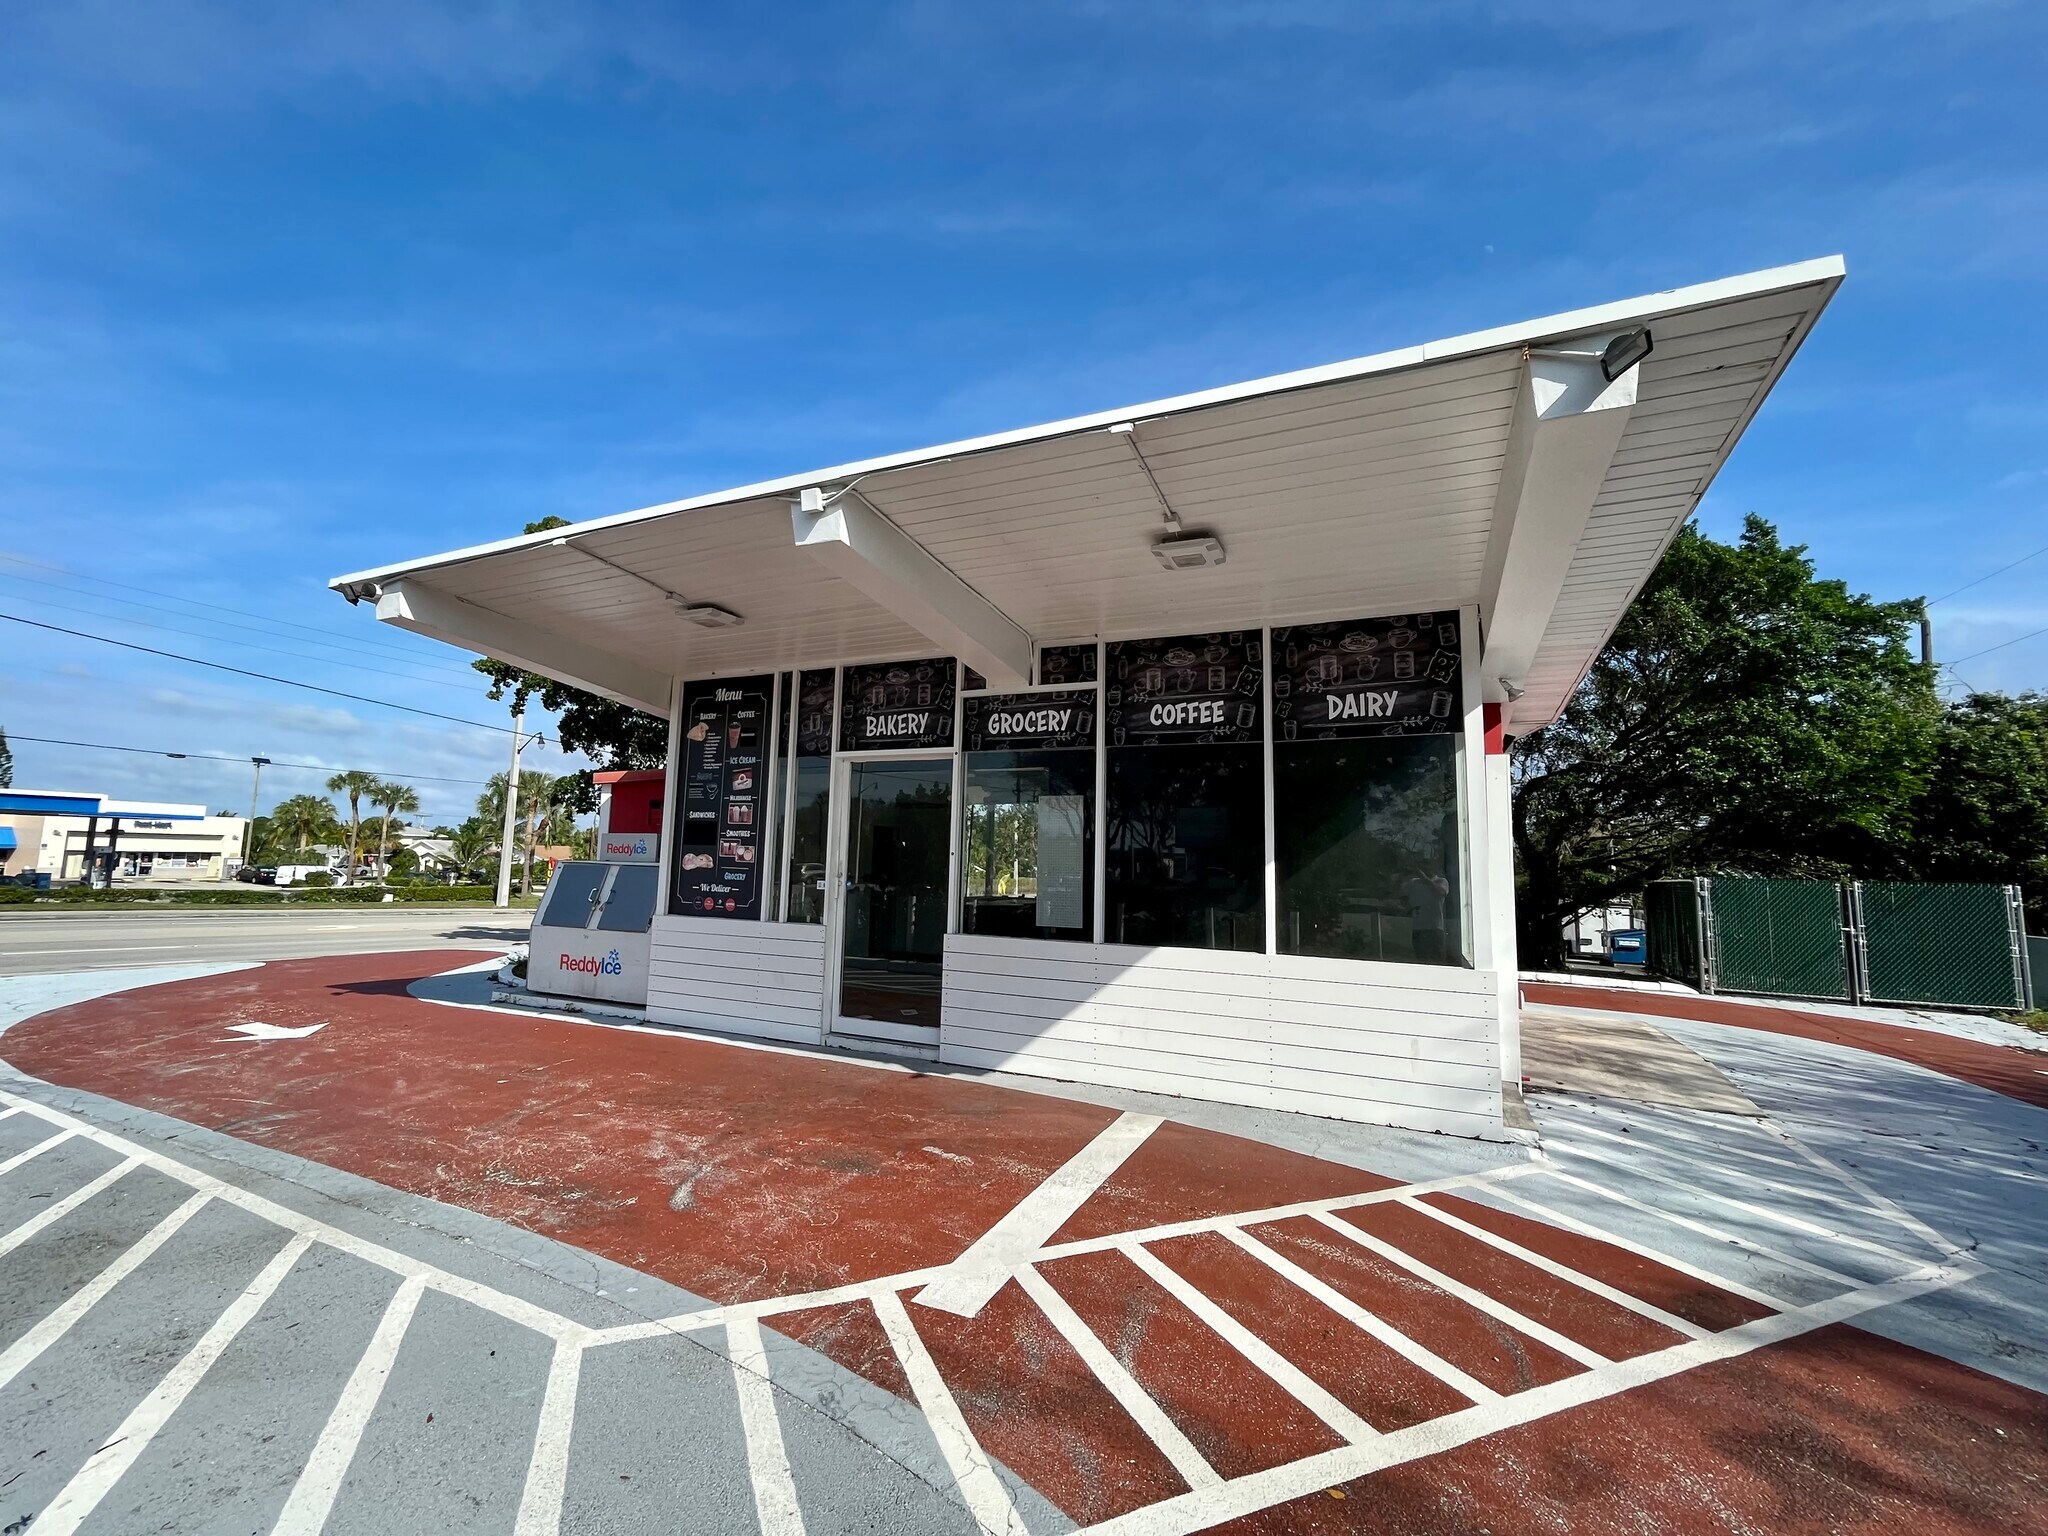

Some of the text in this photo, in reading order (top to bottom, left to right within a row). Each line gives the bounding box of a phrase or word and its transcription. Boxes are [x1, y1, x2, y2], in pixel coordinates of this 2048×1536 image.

[715, 688, 743, 702] Menu
[1326, 690, 1398, 720] DAIRY
[866, 712, 929, 737] BAKERY
[988, 709, 1072, 735] GROCERY
[1149, 700, 1225, 726] COFFEE
[729, 757, 738, 765] ICE
[700, 883, 732, 893] We Deliver
